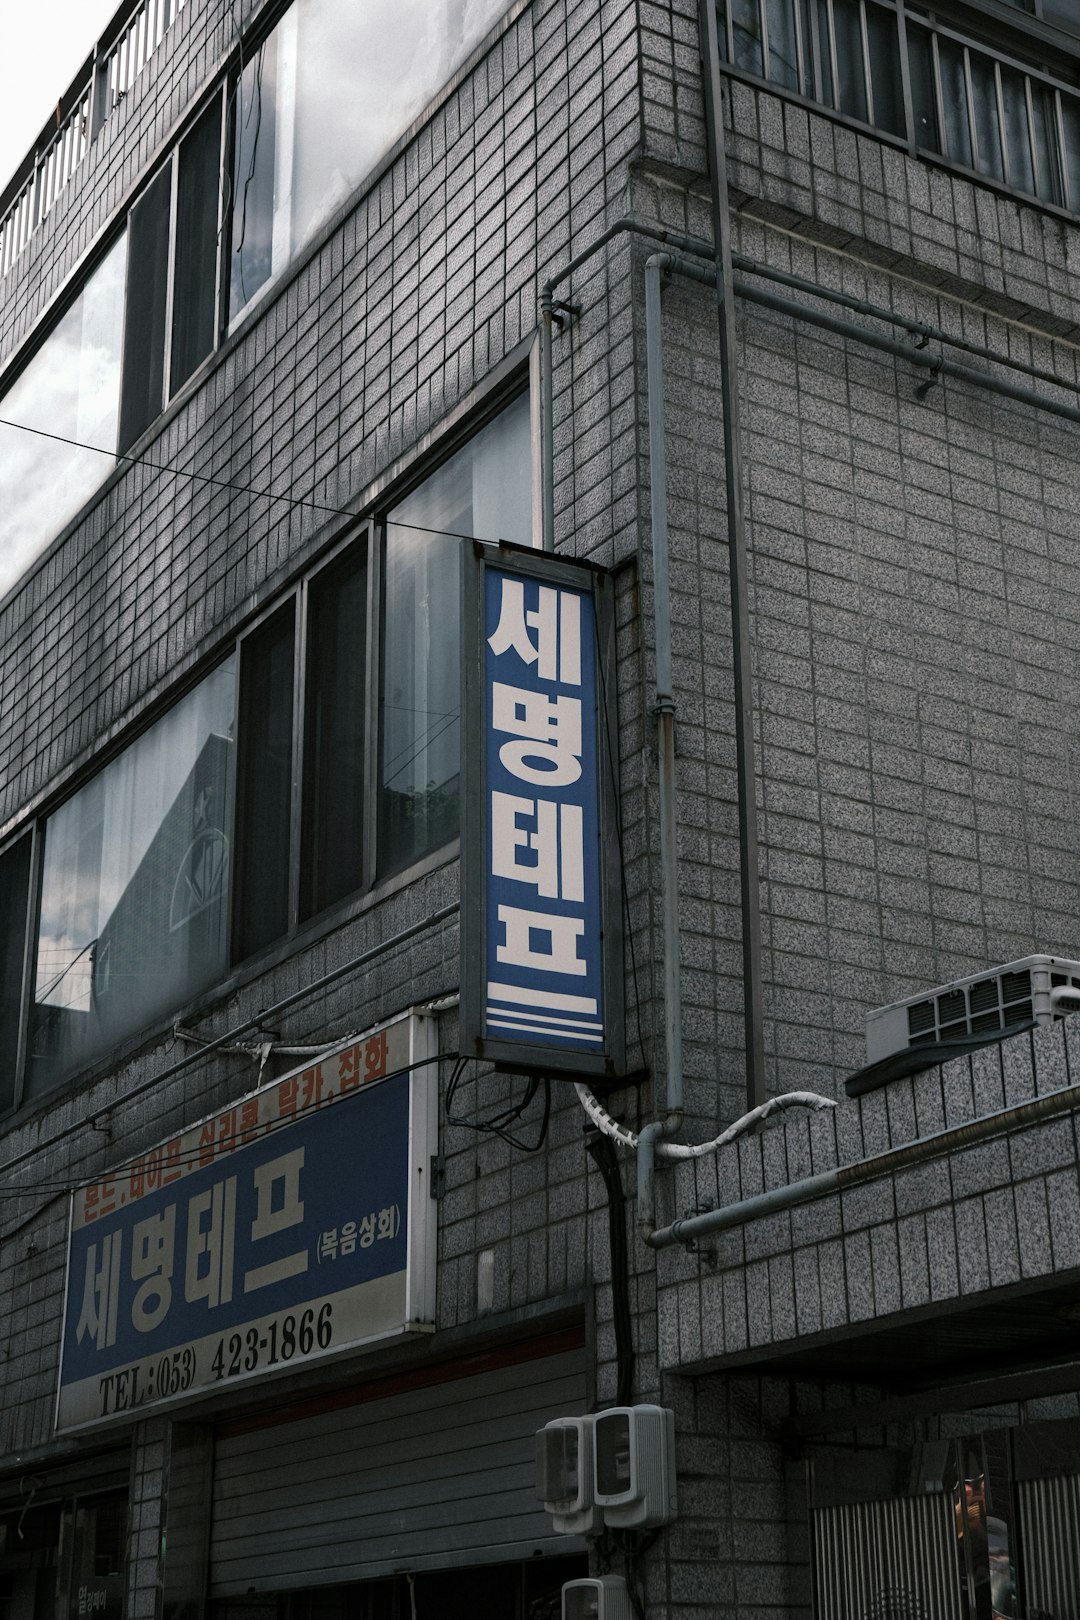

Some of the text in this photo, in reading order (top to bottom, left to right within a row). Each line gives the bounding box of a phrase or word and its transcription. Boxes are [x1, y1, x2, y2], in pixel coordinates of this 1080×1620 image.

[487, 578, 597, 1016] 세명테프
[338, 1032, 389, 1097] 잡화
[76, 1146, 401, 1351] 세명테프 (복음상회)
[211, 1302, 333, 1381] 423-1866
